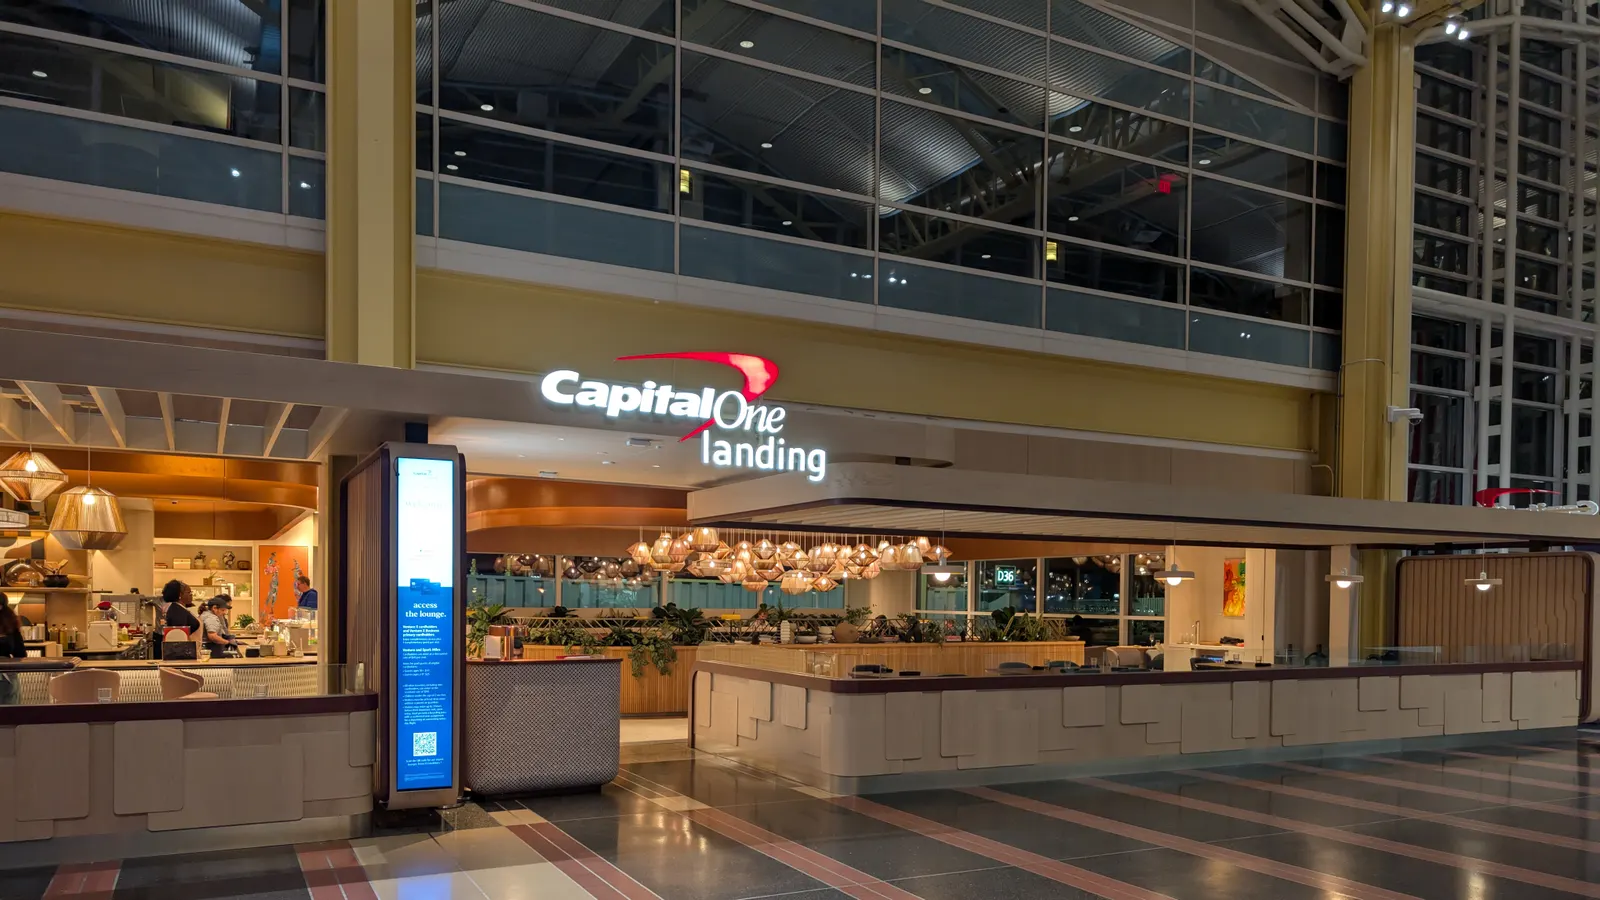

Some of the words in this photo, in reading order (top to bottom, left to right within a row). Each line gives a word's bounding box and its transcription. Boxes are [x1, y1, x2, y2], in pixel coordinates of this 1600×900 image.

[702, 430, 826, 481] landing
[997, 570, 1014, 582] D36
[405, 610, 418, 618] the
[419, 610, 447, 619] lounge.
